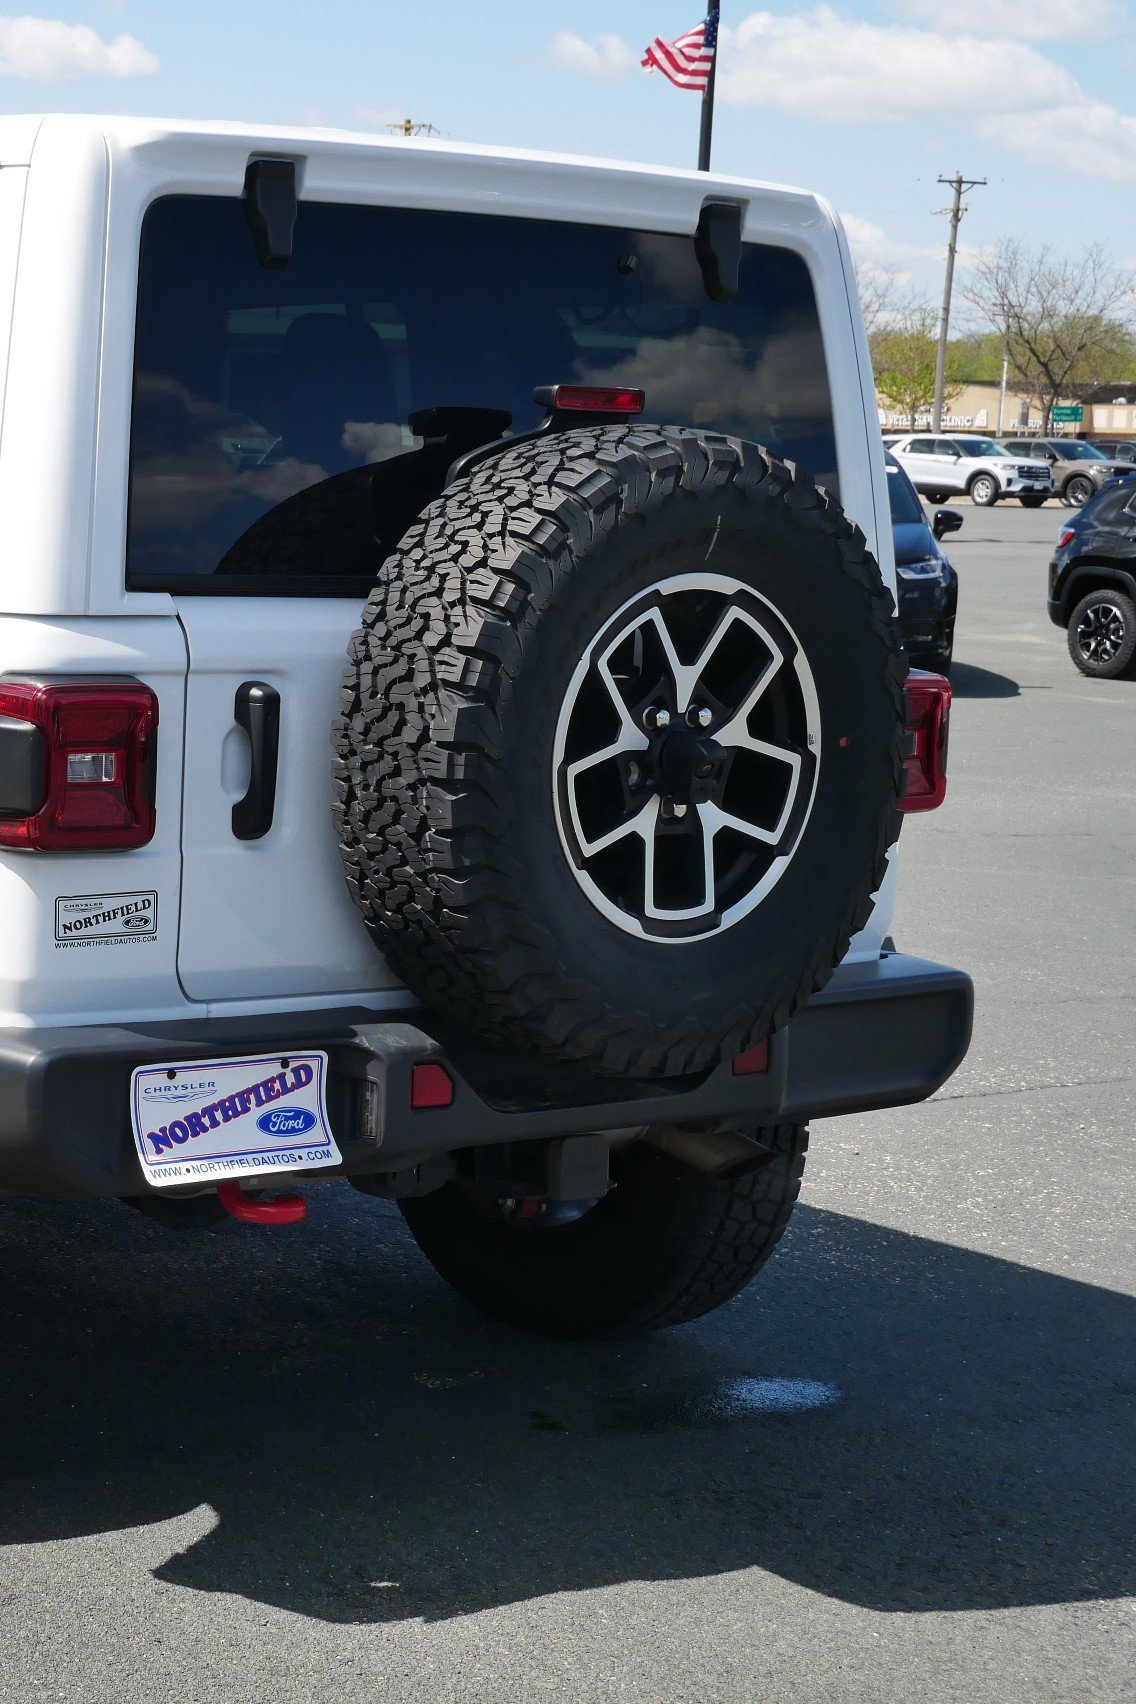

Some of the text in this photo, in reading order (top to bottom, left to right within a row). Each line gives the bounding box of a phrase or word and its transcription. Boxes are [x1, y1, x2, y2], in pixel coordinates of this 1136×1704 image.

[940, 415, 973, 427] CLINIC
[61, 898, 152, 935] NORTHFIELD
[54, 935, 158, 949] WWW.NORTHFIELDAUTOS.COM
[143, 1081, 216, 1095] CHRYSLER
[146, 1063, 314, 1155] NORTHFIELD
[269, 1112, 305, 1132] Ford
